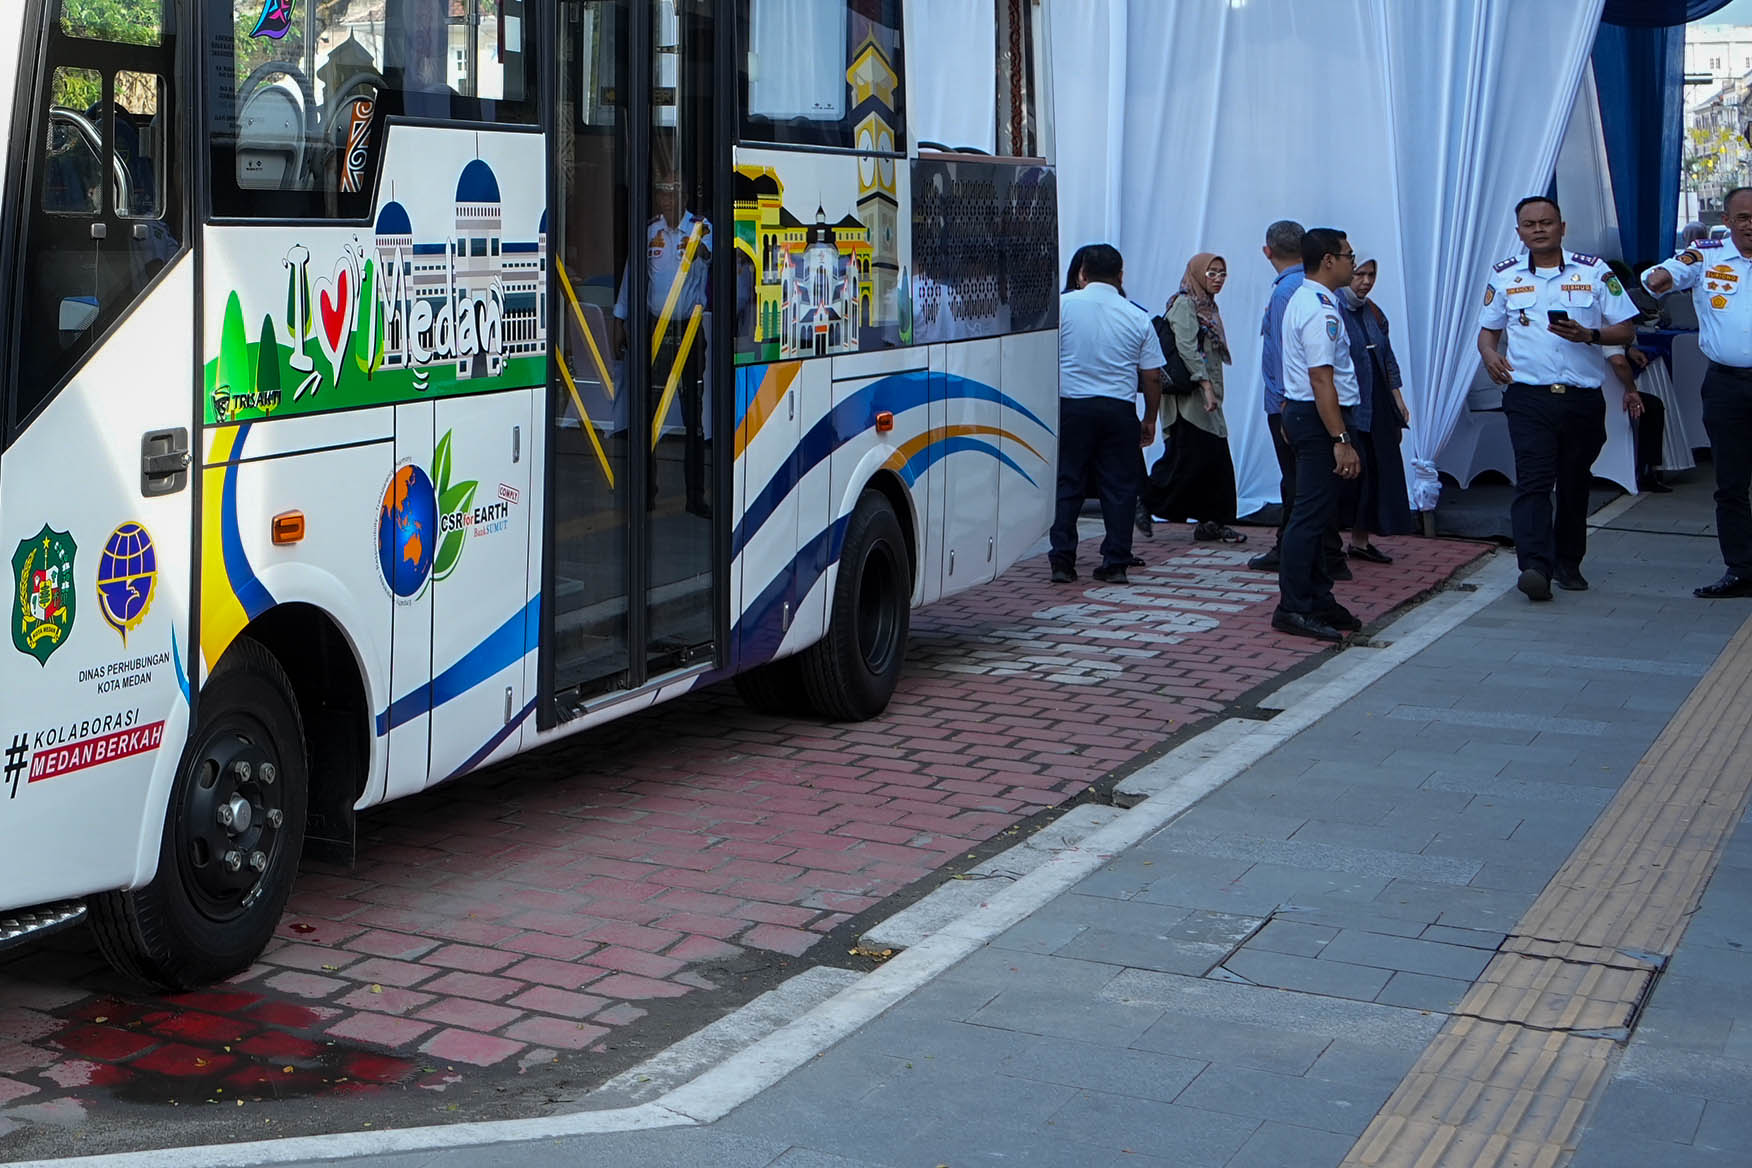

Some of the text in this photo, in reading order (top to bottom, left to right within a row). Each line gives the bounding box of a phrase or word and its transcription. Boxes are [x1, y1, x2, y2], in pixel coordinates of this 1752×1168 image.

[367, 236, 505, 369] Medan
[441, 512, 463, 532] CSR
[474, 501, 508, 525] EARTH
[79, 652, 170, 683] DINAS PERHUBUNGAN
[97, 671, 152, 694] KOTA MEDAN
[34, 708, 140, 750] KOLABORASI
